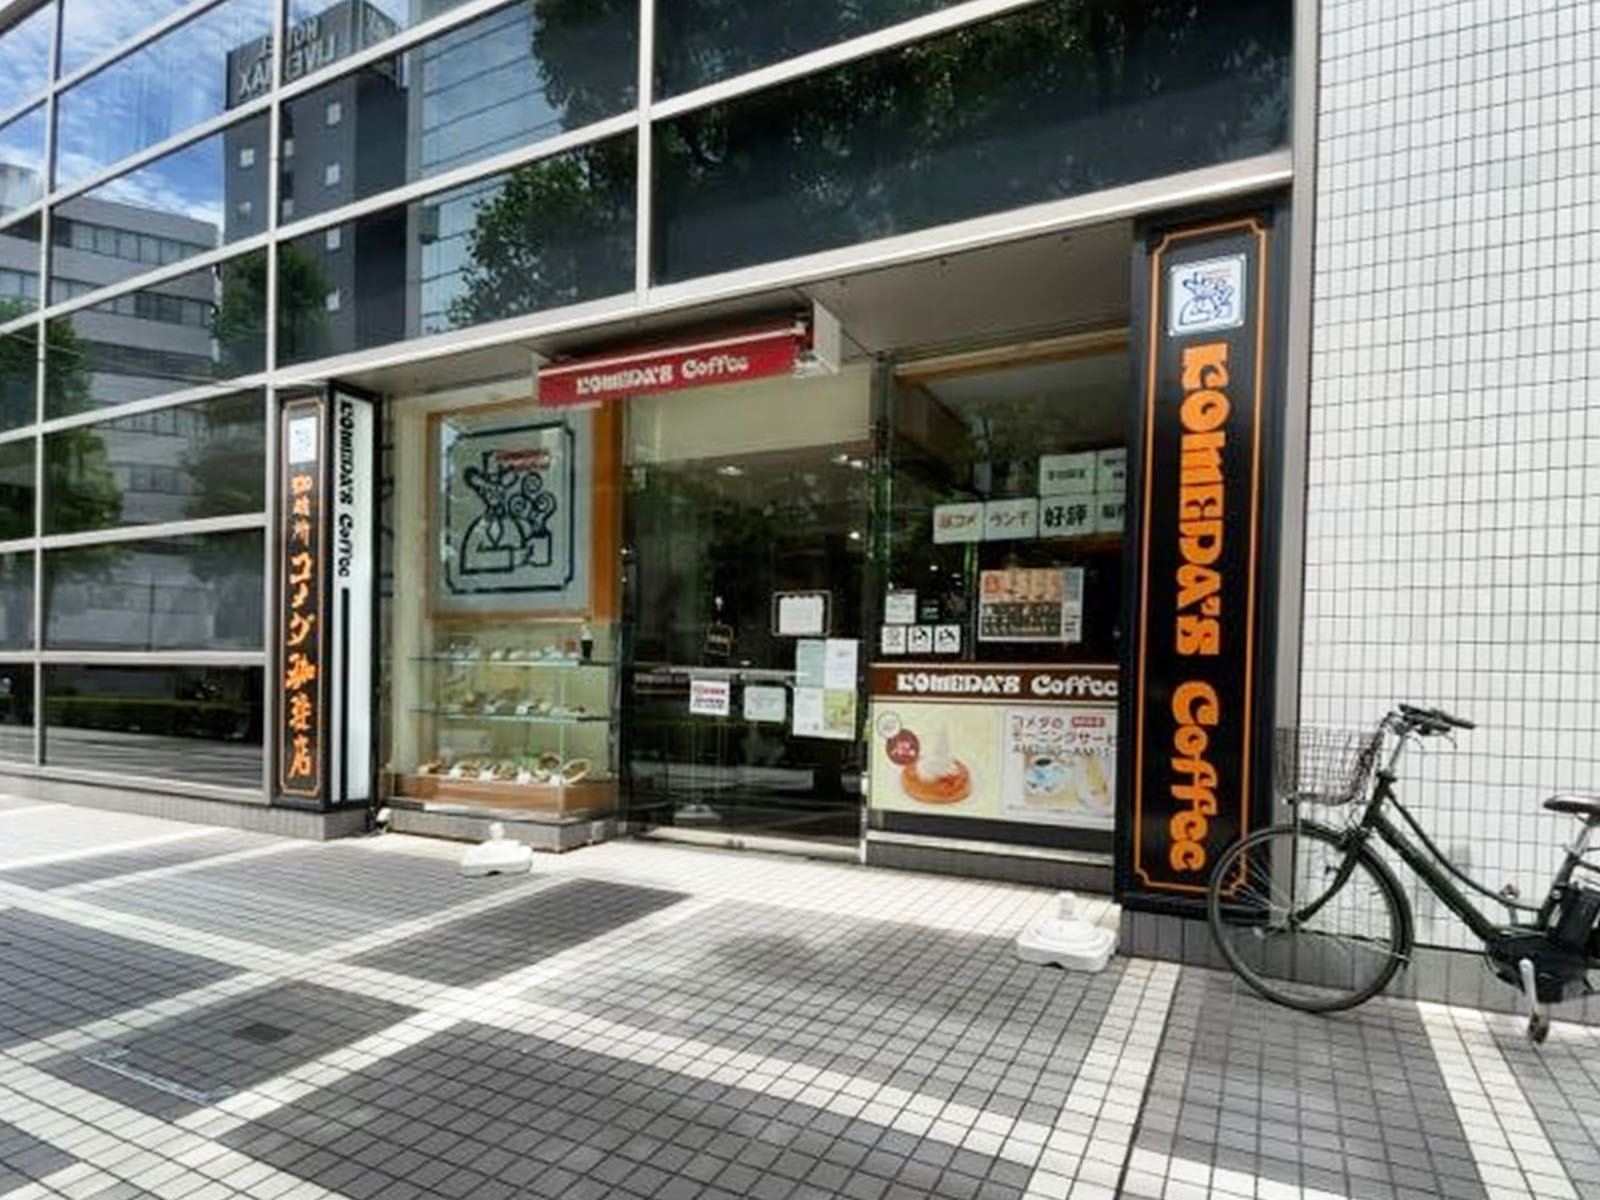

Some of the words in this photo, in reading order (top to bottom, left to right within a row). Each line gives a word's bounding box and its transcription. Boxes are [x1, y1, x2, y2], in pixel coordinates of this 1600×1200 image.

[576, 364, 674, 395] KOMEDA'S
[680, 355, 749, 380] Coffee
[1044, 503, 1088, 529] 好評
[1176, 342, 1230, 656] KOMEDA'S
[896, 672, 1021, 696] KOMEDA'S
[1031, 673, 1119, 697] Coffee
[1170, 680, 1219, 873] Coffee
